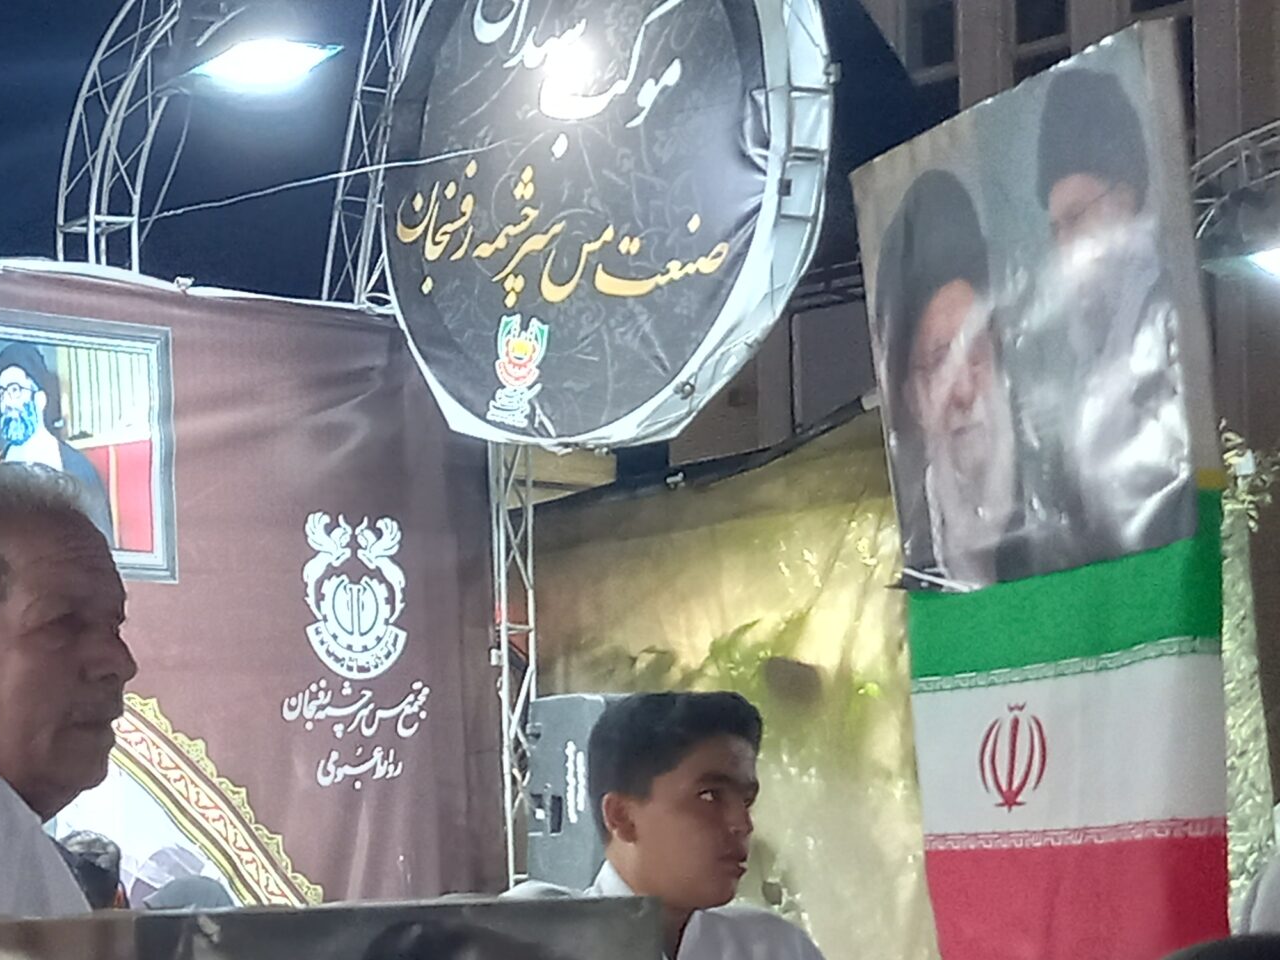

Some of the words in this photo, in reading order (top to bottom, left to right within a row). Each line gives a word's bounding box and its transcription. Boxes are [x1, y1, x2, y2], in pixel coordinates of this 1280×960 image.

[396, 158, 477, 295] رفسنجان
[471, 164, 567, 308] سرچشمه
[539, 224, 613, 303] مس
[594, 213, 731, 297] صنعت
[396, 681, 431, 738] مجتمع
